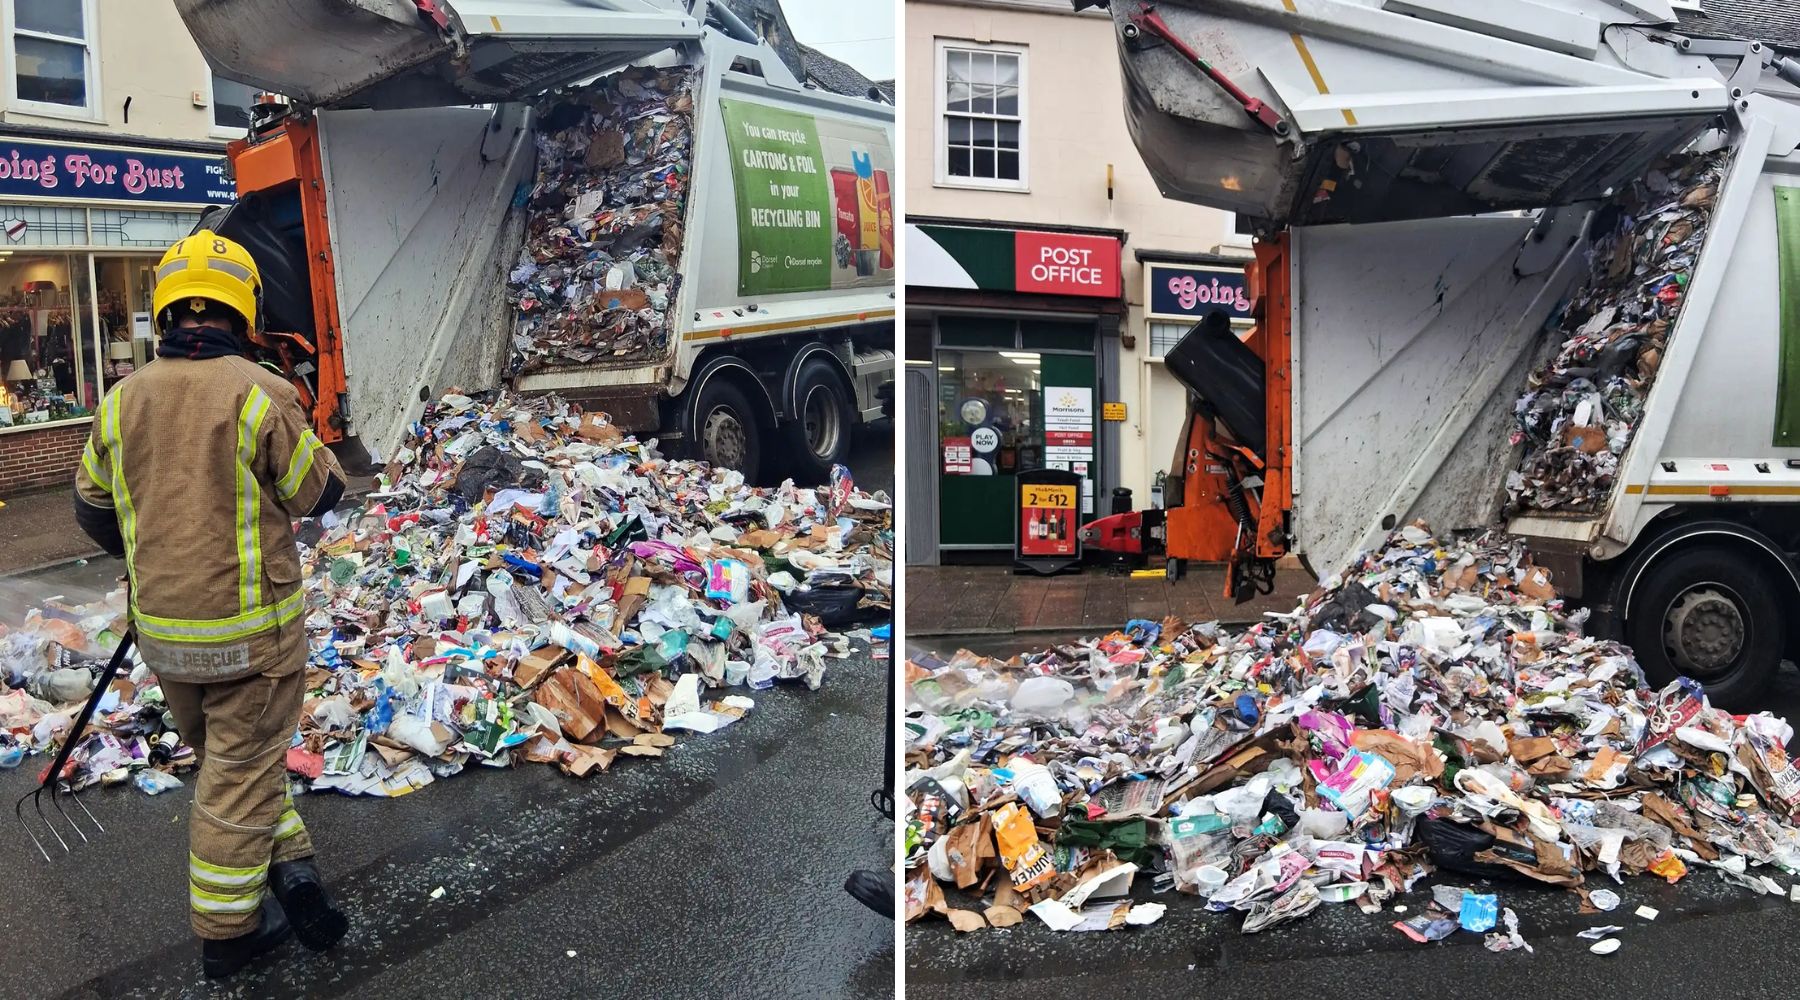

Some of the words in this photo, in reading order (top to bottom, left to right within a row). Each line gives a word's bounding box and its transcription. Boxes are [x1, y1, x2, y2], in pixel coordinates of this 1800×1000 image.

[743, 121, 760, 138] You
[761, 127, 777, 140] can
[777, 129, 806, 145] recycle
[743, 149, 788, 171] CARTONS
[789, 157, 796, 172] &
[796, 155, 817, 174] FOIL
[65, 154, 118, 188] For
[123, 158, 185, 194] Bust
[769, 179, 780, 196] in
[780, 184, 800, 200] your
[751, 207, 803, 228] RECYCLING
[805, 210, 820, 228] BIN
[863, 221, 877, 232] JUICE
[212, 239, 227, 254] 8
[1041, 246, 1092, 266] POST
[761, 255, 778, 263] Dorset
[1031, 264, 1103, 285] OFFICE
[1168, 276, 1250, 312] Going
[1029, 493, 1038, 505] 2
[1048, 493, 1068, 506] £12
[183, 650, 243, 668] RESCUE
